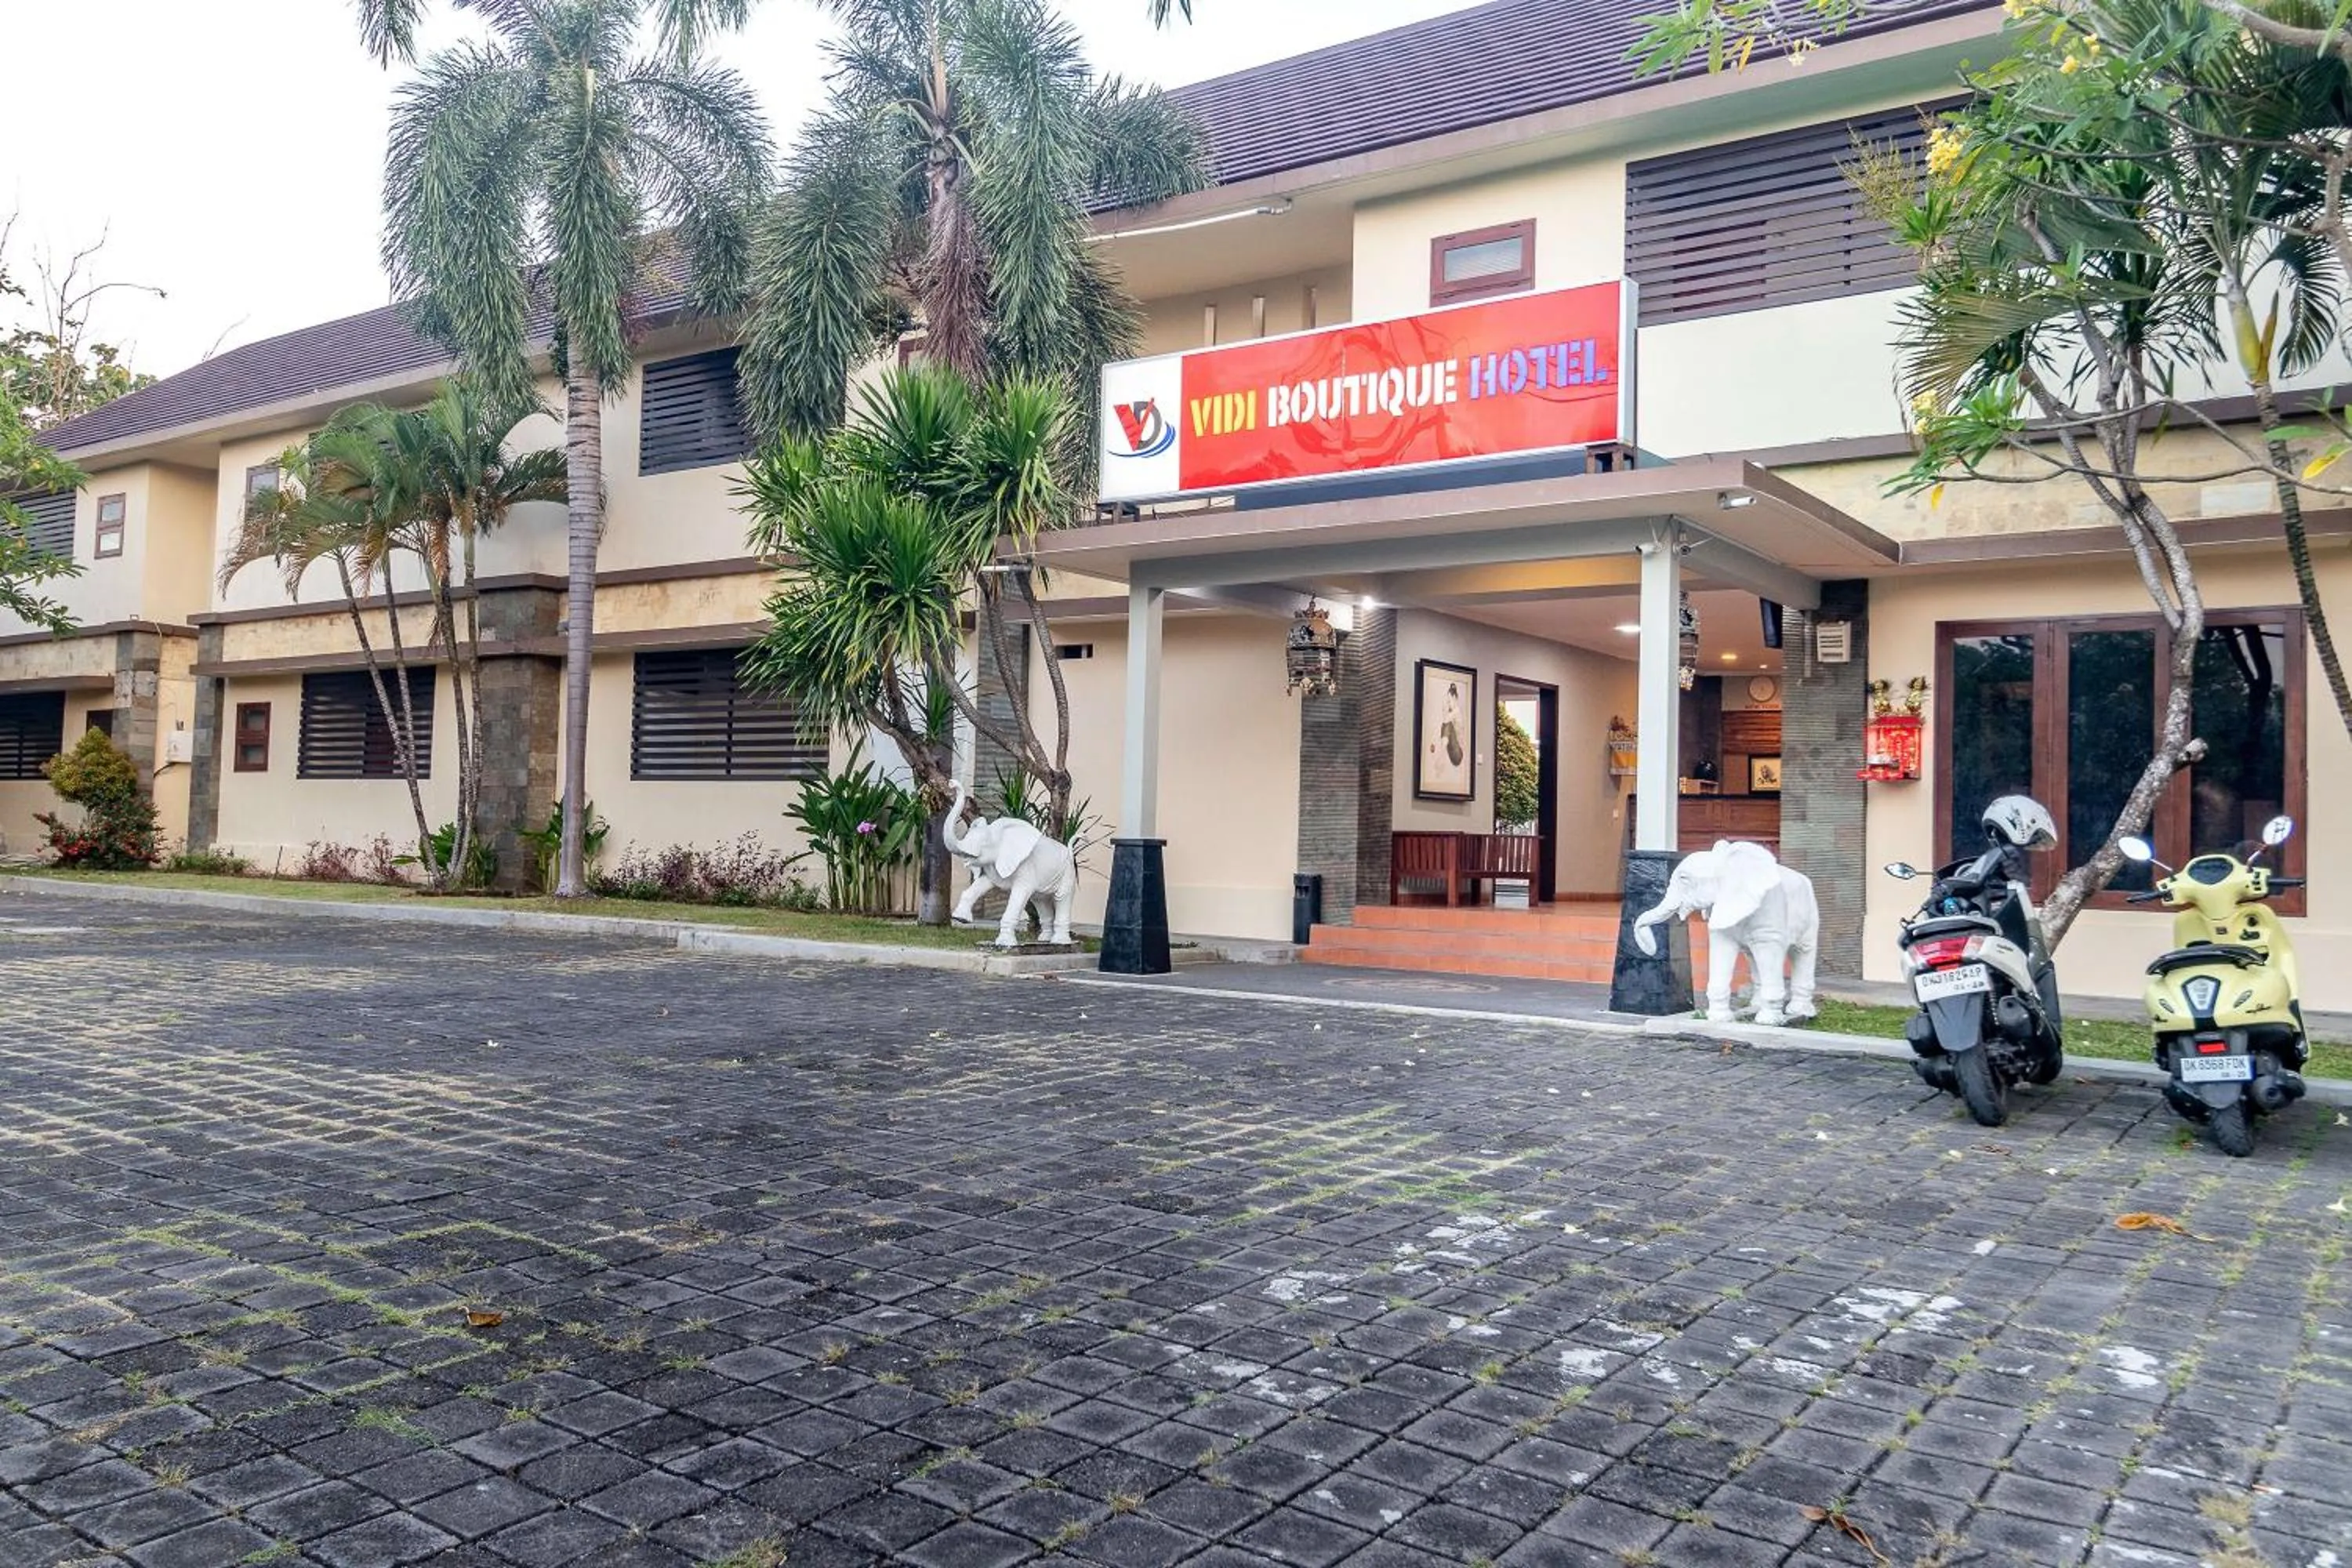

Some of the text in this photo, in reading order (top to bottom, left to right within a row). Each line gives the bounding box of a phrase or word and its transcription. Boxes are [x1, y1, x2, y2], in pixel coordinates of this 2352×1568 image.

[1190, 338, 1607, 437] VIDI BOUTIQUE HOTEL
